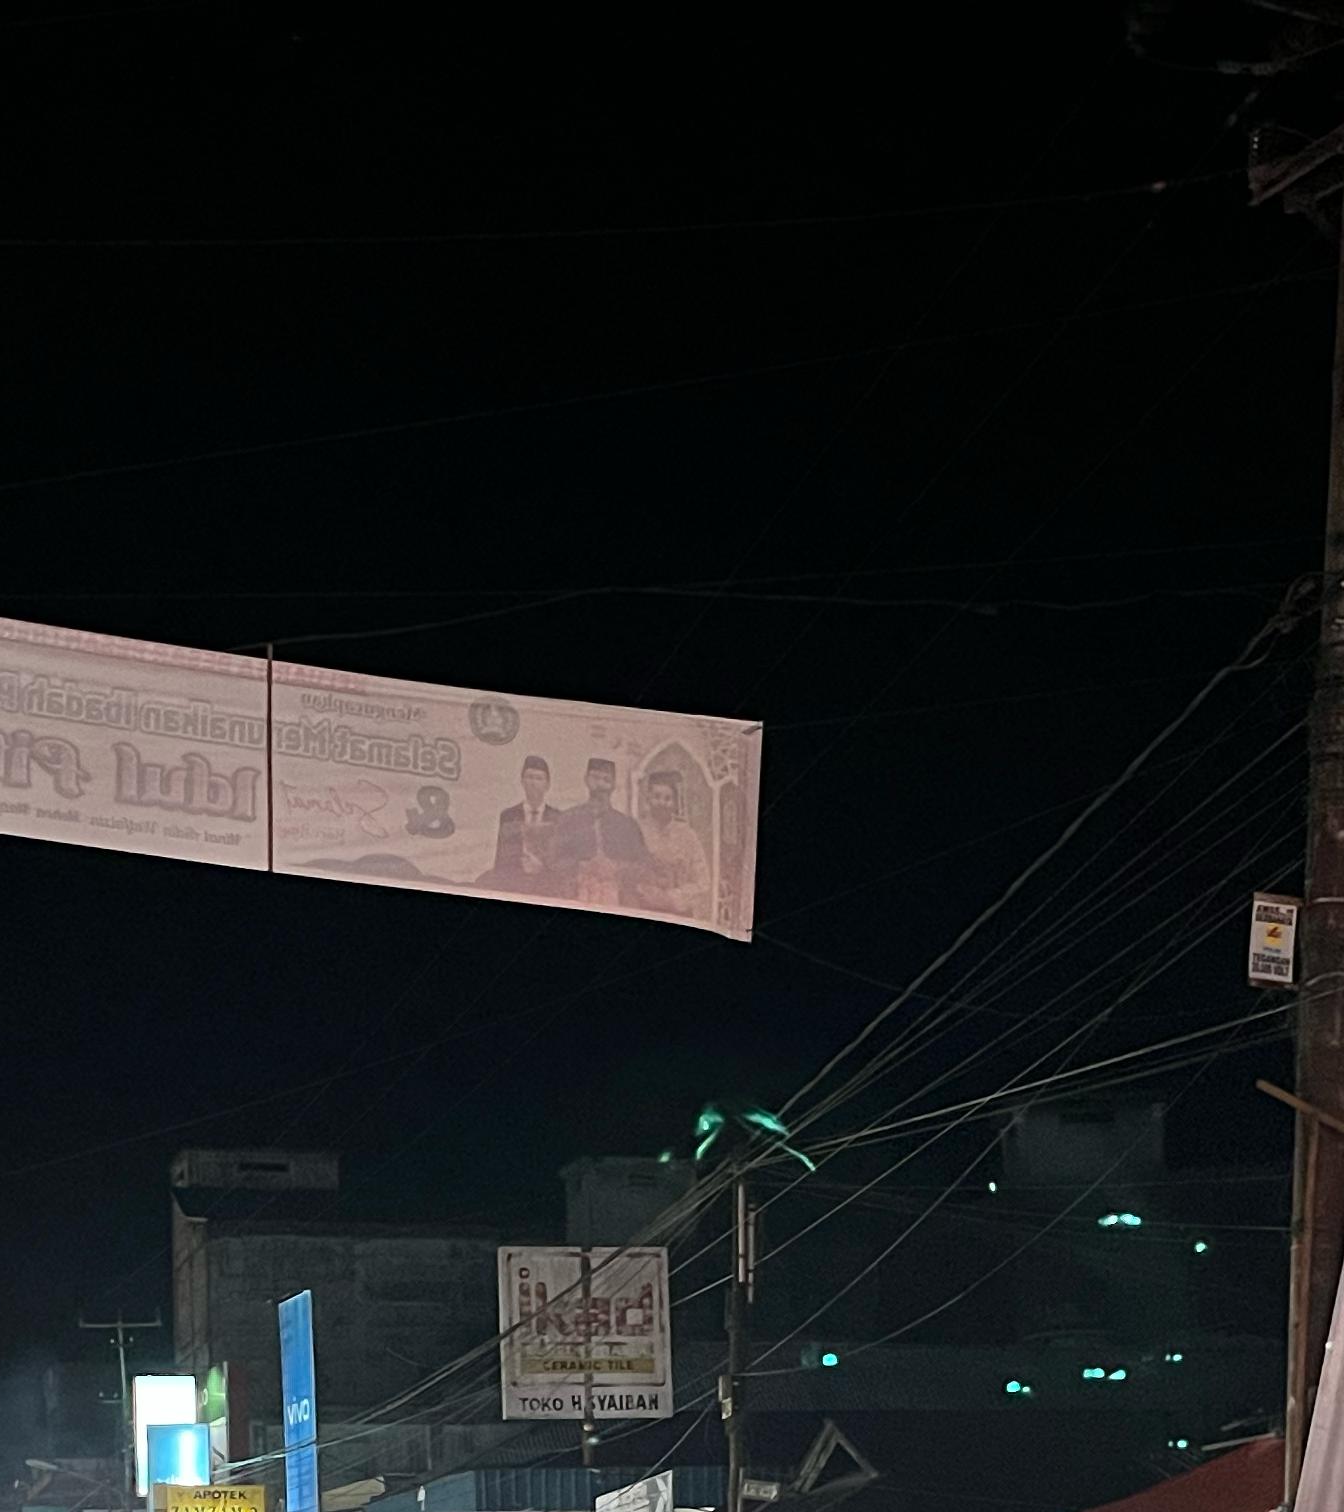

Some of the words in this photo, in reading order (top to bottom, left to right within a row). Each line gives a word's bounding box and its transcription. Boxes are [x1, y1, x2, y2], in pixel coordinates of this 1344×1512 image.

[542, 1359, 602, 1372] CERAMIC
[606, 1359, 634, 1372] TILE
[519, 1396, 564, 1412] TOKO
[286, 1397, 311, 1427] vivo
[192, 1490, 248, 1500] APOTEK
